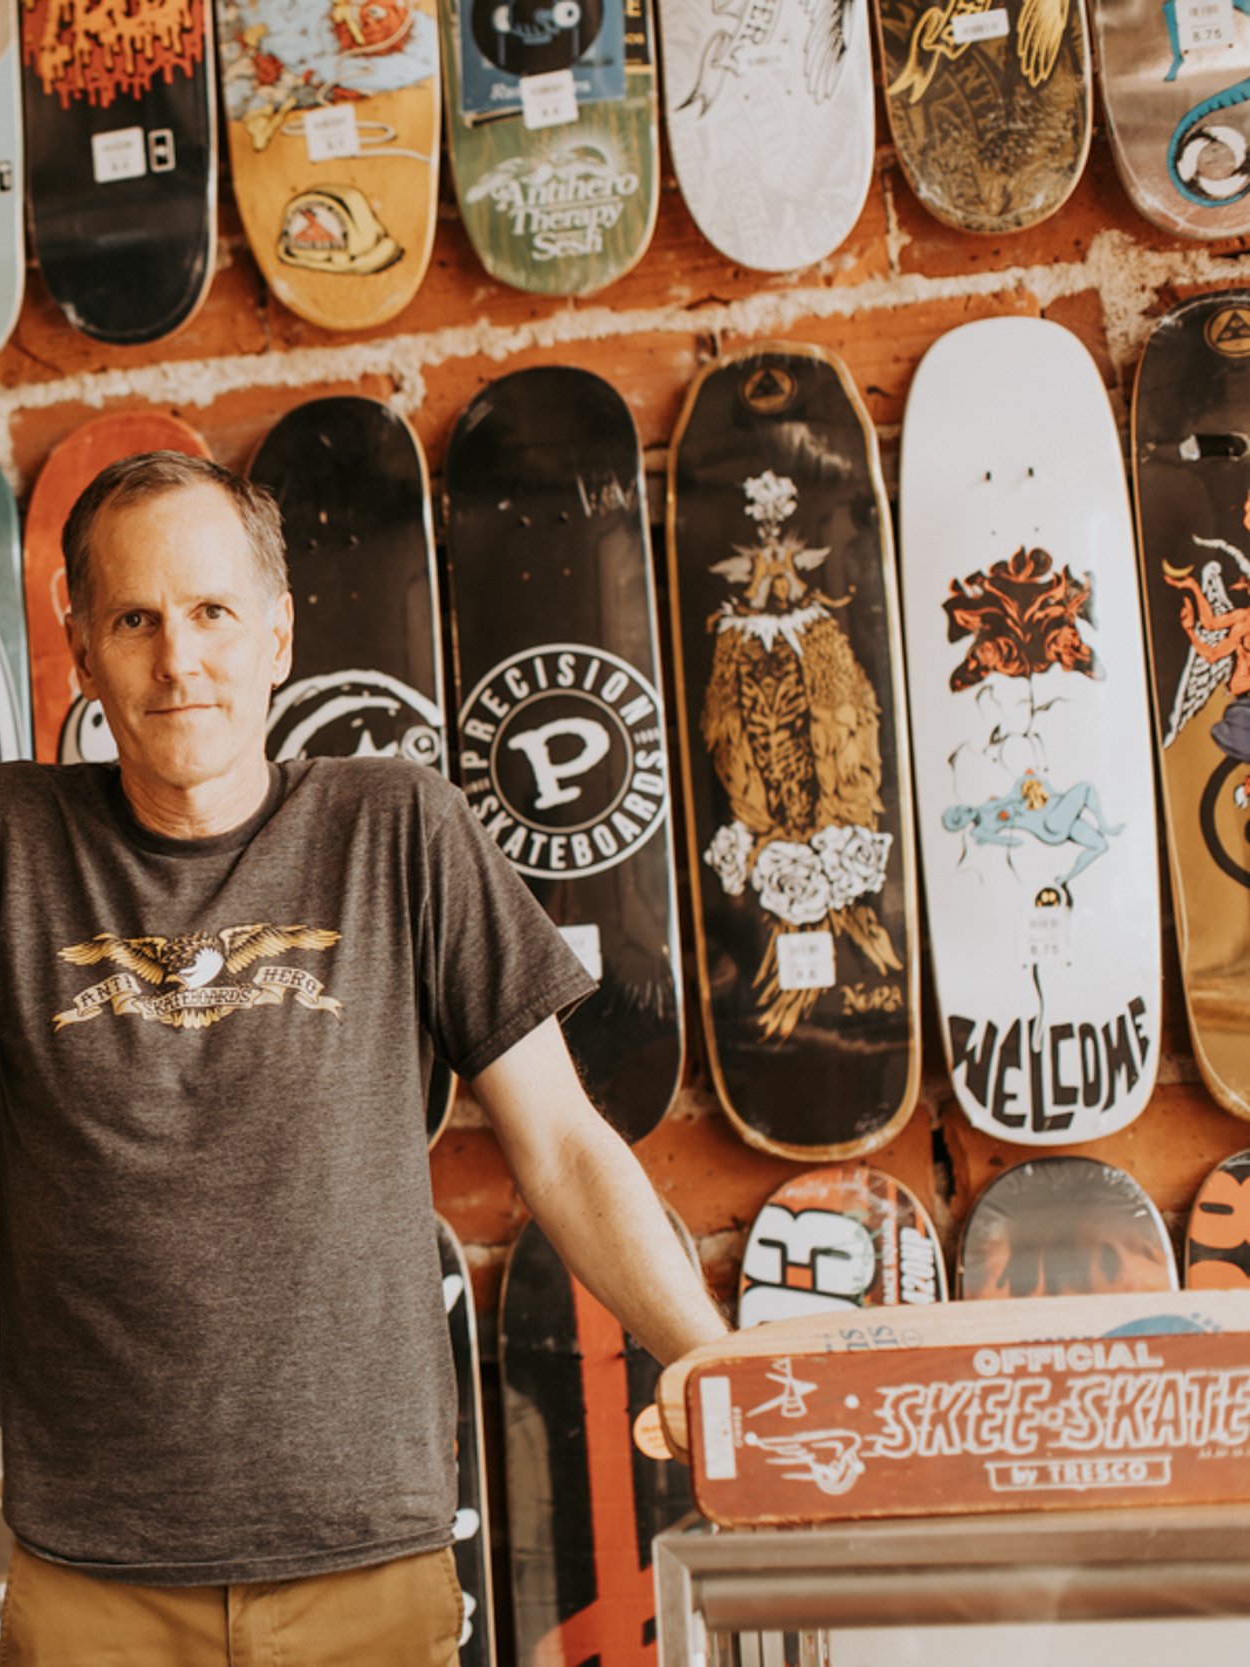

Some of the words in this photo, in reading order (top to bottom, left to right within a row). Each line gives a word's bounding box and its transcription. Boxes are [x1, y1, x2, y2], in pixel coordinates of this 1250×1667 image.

[508, 199, 625, 236] Therapy
[531, 223, 603, 261] Sesh
[461, 653, 655, 769] PRECISION
[143, 987, 252, 1018] SKATEBOARDS
[948, 996, 1150, 1133] WELCOME
[973, 1341, 1164, 1376] OFFICIAL
[1012, 1463, 1039, 1486] by
[1049, 1460, 1148, 1484] TRESCO
